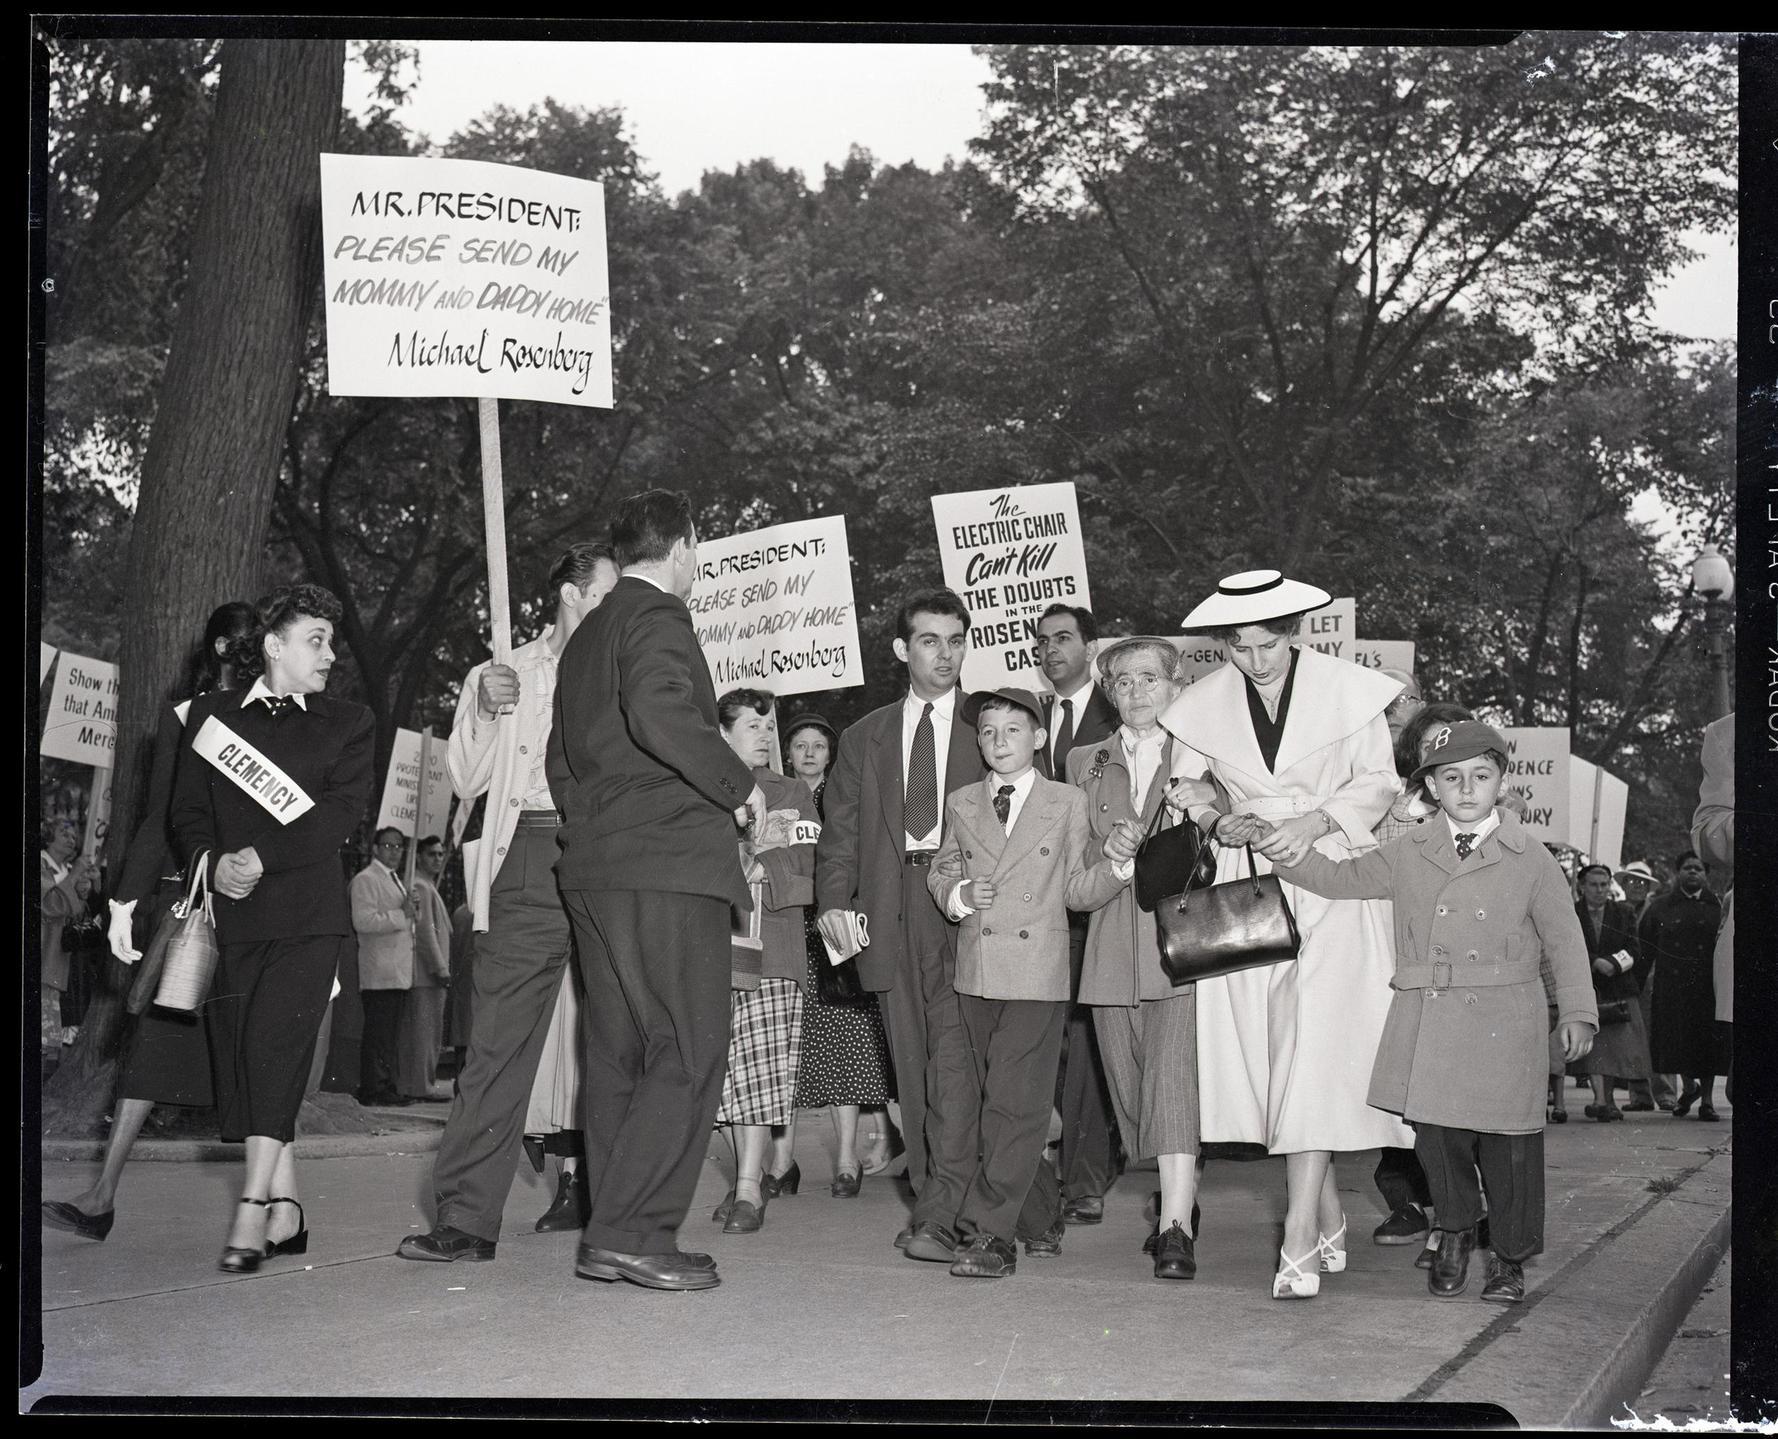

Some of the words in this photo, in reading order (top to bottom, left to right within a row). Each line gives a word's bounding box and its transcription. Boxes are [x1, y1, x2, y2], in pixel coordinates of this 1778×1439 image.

[334, 235, 450, 265] PLEASE
[459, 238, 532, 266] SEND
[536, 246, 579, 276] MY
[333, 278, 439, 311] MOMMY
[434, 285, 474, 309] AND
[476, 281, 551, 318] DADDY
[388, 328, 492, 374] Michael
[500, 331, 594, 395] Rosenberg
[989, 494, 1026, 519] The
[952, 518, 1022, 550] ELECTRIC
[1024, 512, 1068, 539] CHAIR
[965, 547, 1018, 586] Can't
[1016, 542, 1057, 578] Kill
[689, 588, 737, 613] PLEASE
[742, 578, 777, 608] SEND
[784, 570, 815, 596] MY
[963, 587, 999, 611] THE
[1004, 576, 1076, 605] DOUBTS
[737, 625, 755, 640] AND
[756, 608, 803, 635] DADDY
[1005, 608, 1018, 617] IN
[1021, 604, 1043, 615] THE
[1311, 615, 1343, 634] LET
[971, 617, 1041, 649] ROSEN
[714, 649, 767, 685] Michael
[770, 639, 846, 677] Rosenberg
[1004, 646, 1041, 671] CAS
[69, 667, 103, 691] Show
[106, 678, 120, 696] th
[64, 694, 88, 716] that
[78, 726, 115, 749] Merc
[217, 743, 298, 813] CLEMENCY
[1508, 760, 1554, 775] DENCE
[795, 826, 819, 841] CLE
